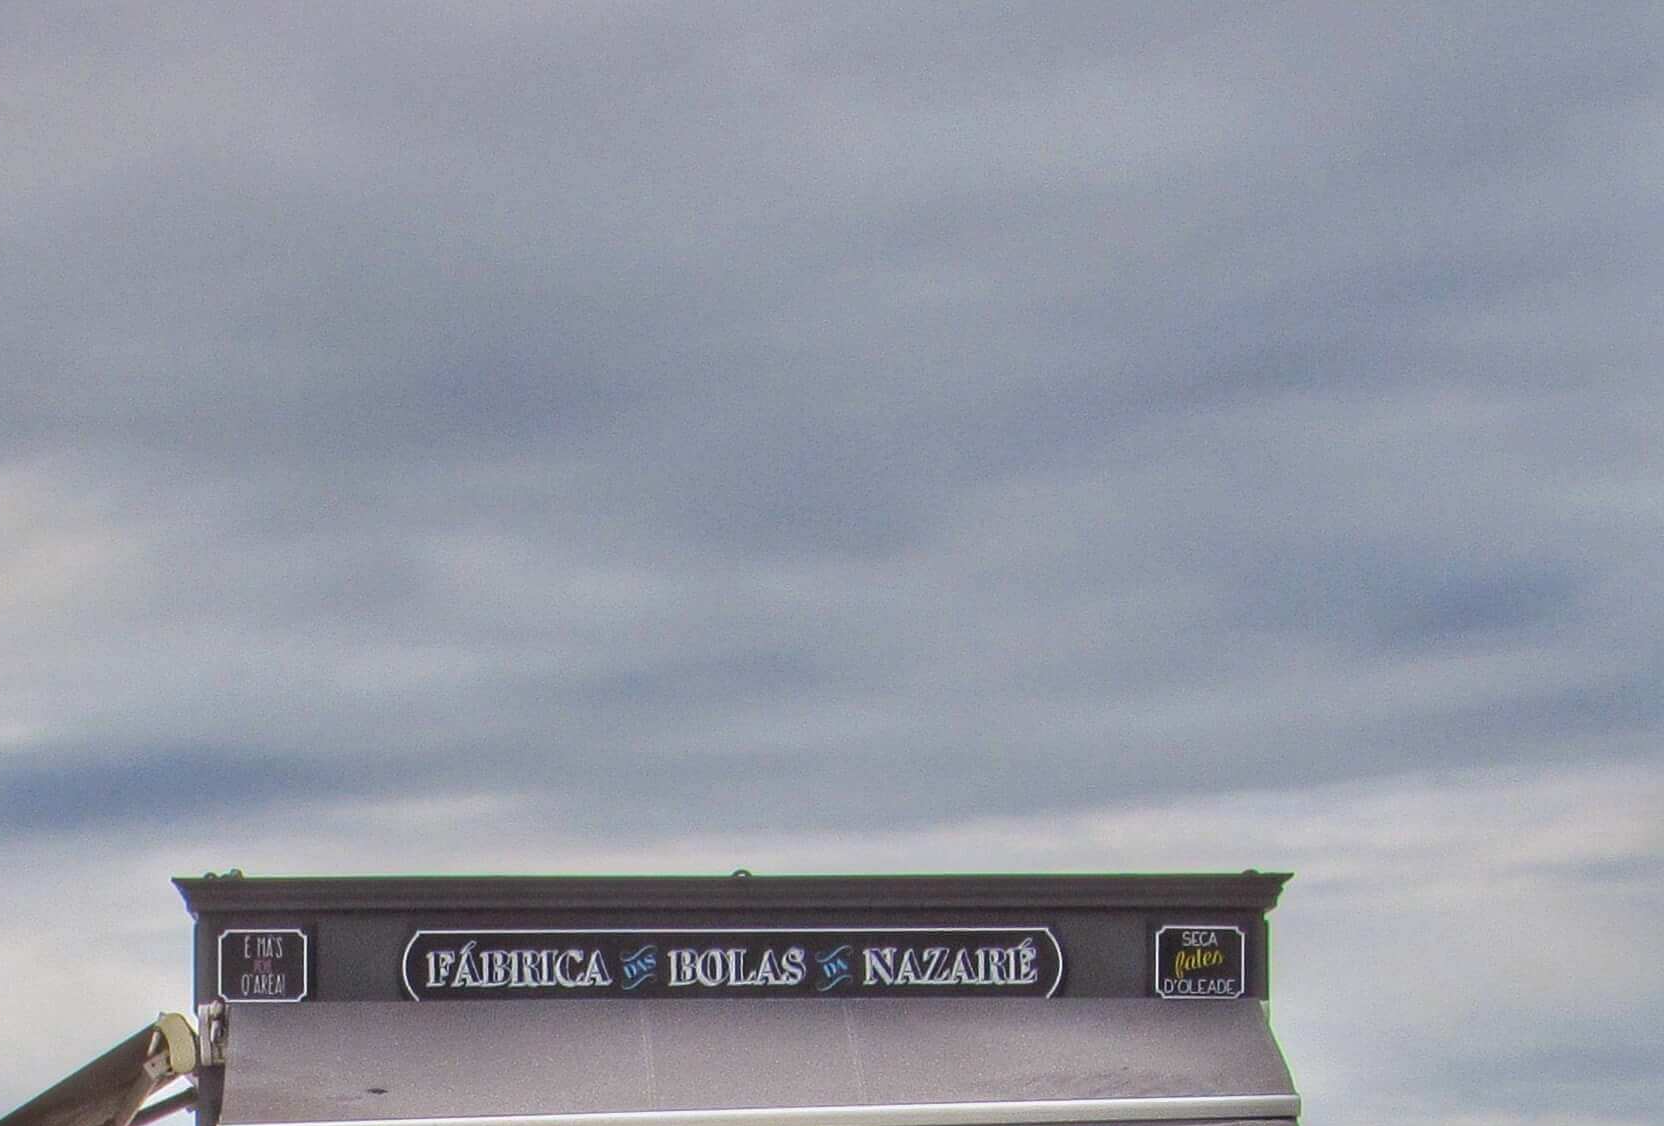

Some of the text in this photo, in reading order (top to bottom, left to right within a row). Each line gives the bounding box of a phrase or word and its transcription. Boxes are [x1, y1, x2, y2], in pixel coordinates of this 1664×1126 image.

[425, 940, 613, 988] FÁBRICA
[667, 947, 806, 987] BOLAS
[862, 938, 1037, 986] NAZARÉ
